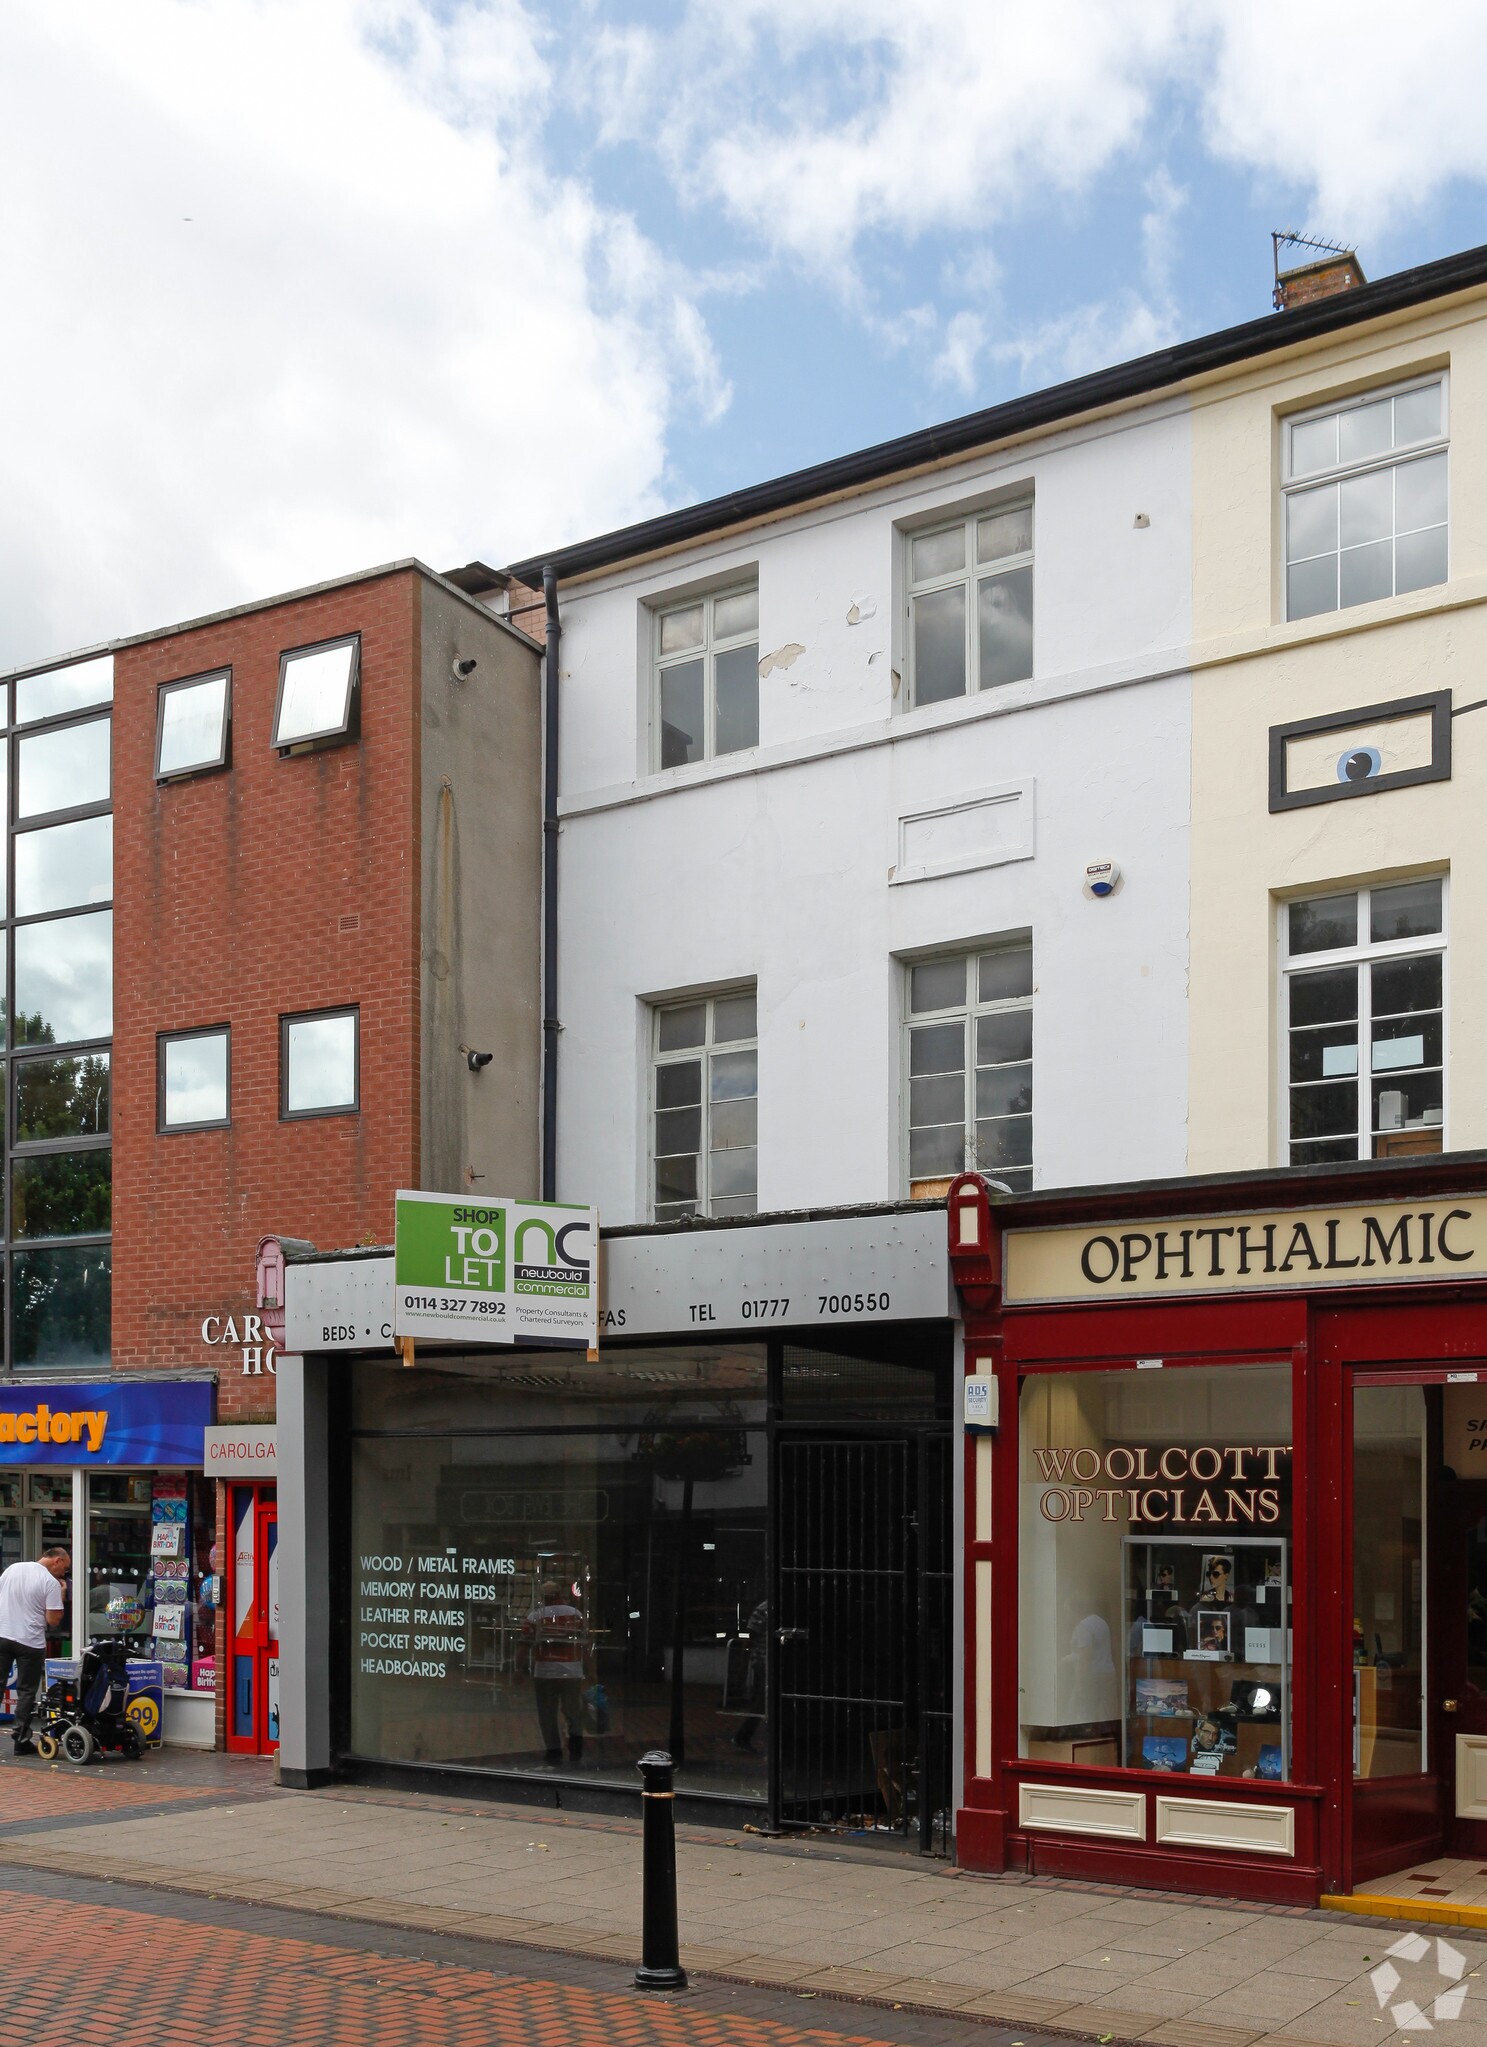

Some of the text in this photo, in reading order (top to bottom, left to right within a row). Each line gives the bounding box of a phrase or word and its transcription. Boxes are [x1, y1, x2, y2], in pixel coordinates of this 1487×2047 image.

[453, 1208, 499, 1224] SHOP
[450, 1226, 499, 1257] TO
[1080, 1209, 1475, 1284] OPHTHALMIC
[445, 1256, 501, 1287] LET
[521, 1269, 582, 1281] newbould
[517, 1283, 587, 1296] commercial
[404, 1296, 506, 1315] 0114 327 7892
[515, 1307, 543, 1316] Property
[544, 1308, 582, 1318] Consultants
[322, 1325, 356, 1341] BEDS
[380, 1323, 396, 1339] C
[689, 1303, 716, 1322] TEL
[741, 1299, 790, 1319] 01777
[818, 1292, 890, 1314] 700550
[405, 1311, 506, 1323] www.newbouldcommercial.co.uk
[520, 1316, 584, 1326] Chartered Surveyors
[201, 1315, 275, 1345] CAR
[0, 1404, 108, 1452] actory
[210, 1442, 278, 1459] CAROLGA
[1033, 1447, 1287, 1481] WOOLCOTT
[1039, 1488, 1280, 1523] OPTICIANS
[360, 1556, 403, 1572] WOOD
[418, 1557, 458, 1573] METAL
[462, 1558, 515, 1575] FRAMES
[360, 1582, 496, 1601] MEMORY FOAM BEDS
[360, 1607, 465, 1626] LEATHER FRAMES
[360, 1632, 466, 1653] POCKET SPRUNG
[360, 1658, 446, 1679] HEADBOARDS
